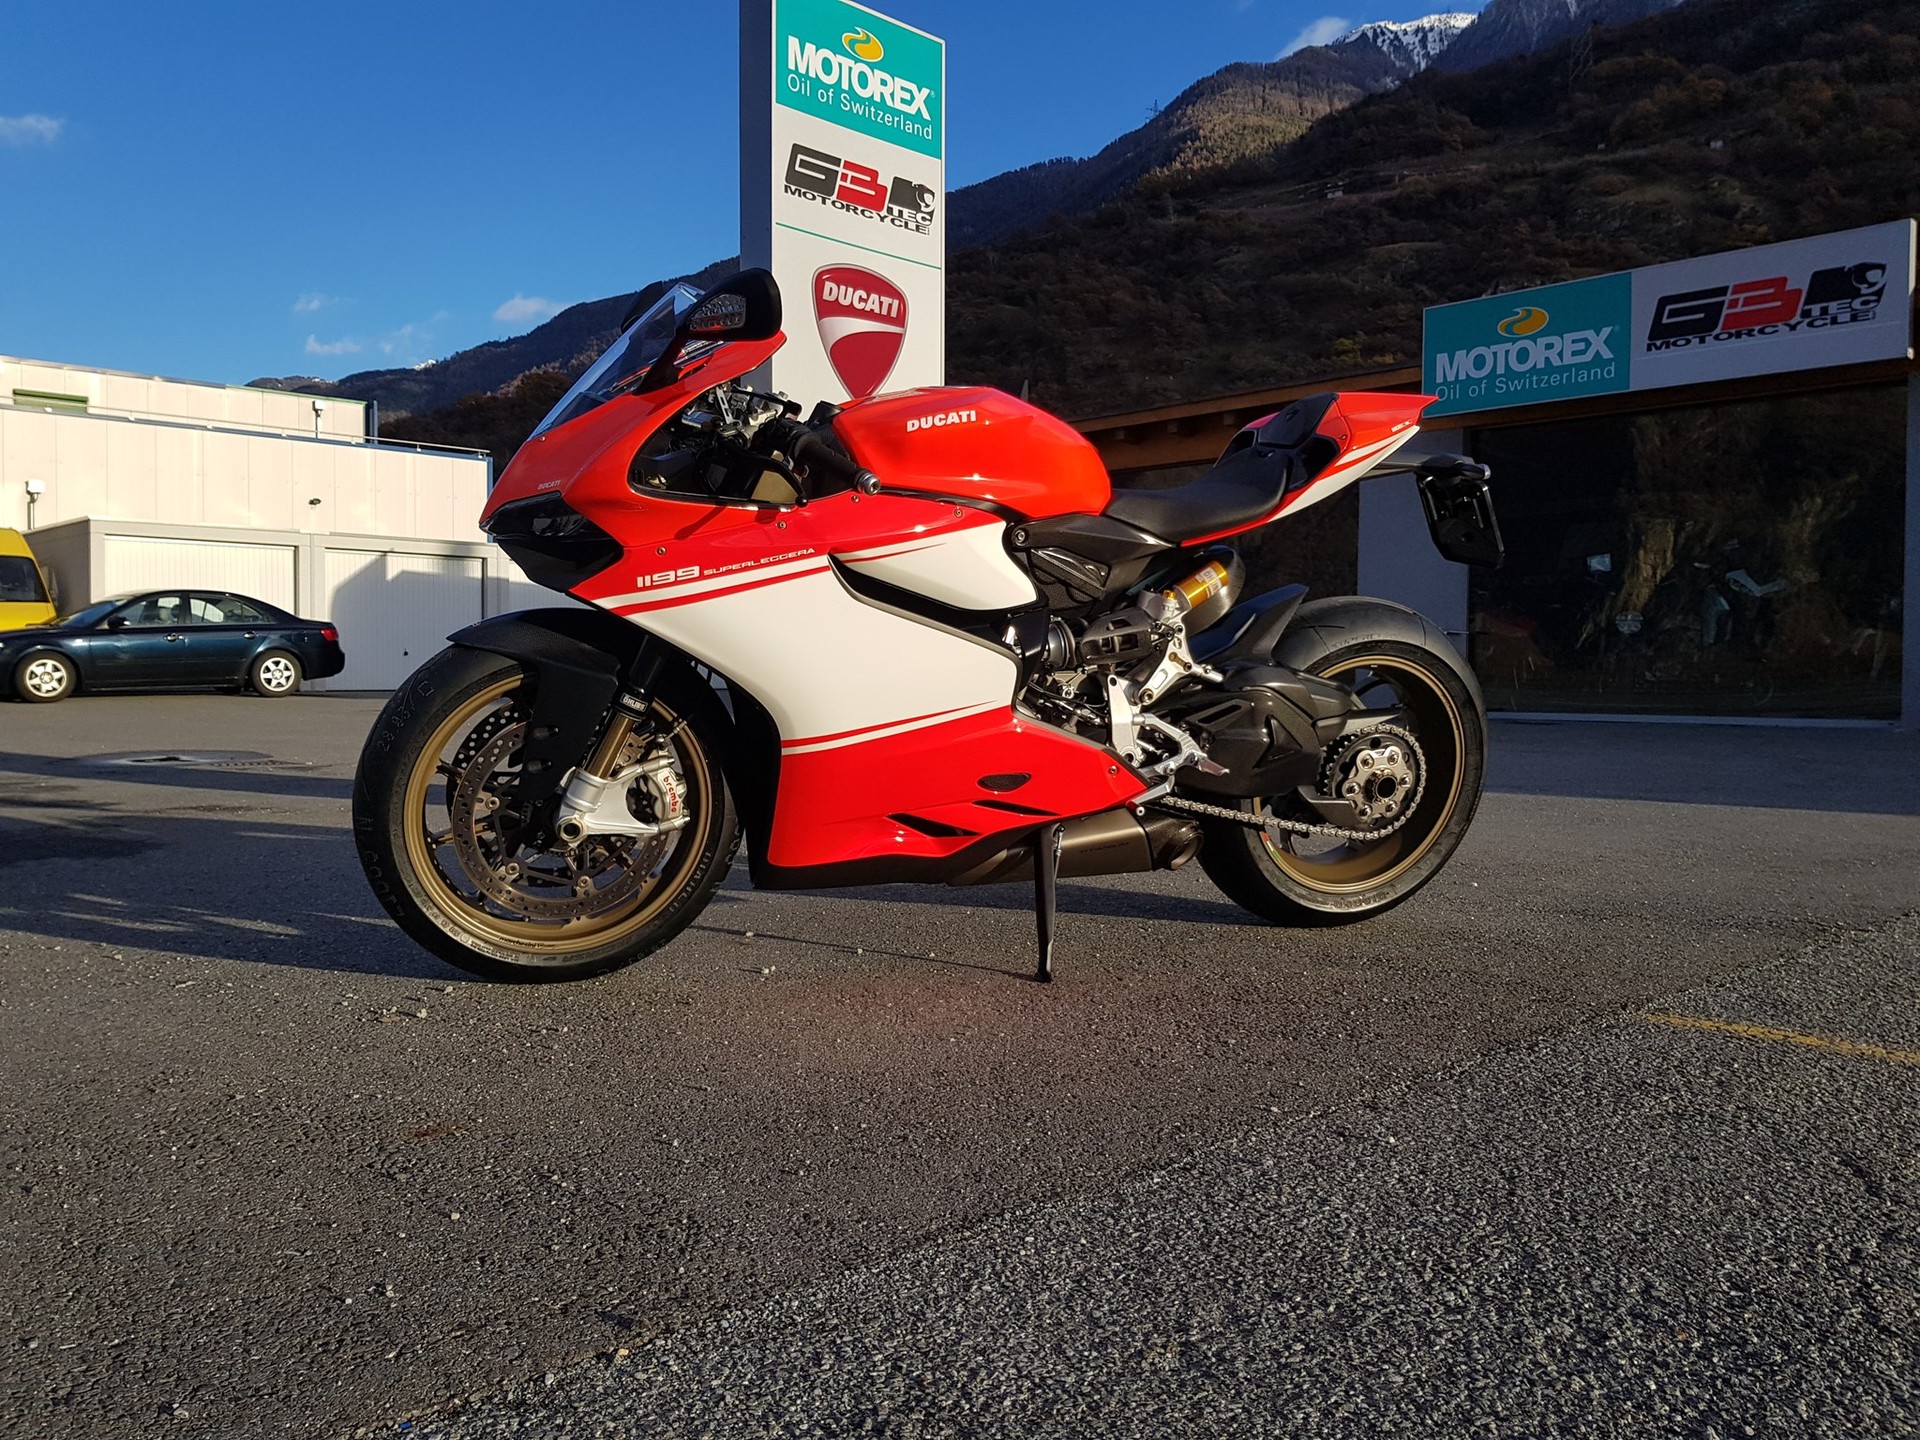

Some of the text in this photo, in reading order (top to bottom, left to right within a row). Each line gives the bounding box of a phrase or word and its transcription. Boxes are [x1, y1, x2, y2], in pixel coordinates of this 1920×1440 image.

[788, 35, 931, 121] MOTOREX
[787, 73, 932, 140] Oil of Switzerland
[784, 184, 928, 235] MOTORCYCLE
[822, 281, 899, 318] DUCATI
[1646, 312, 1874, 352] MOTORCYCLE
[1435, 326, 1614, 383] MOTOREX
[1435, 361, 1615, 401] Oil of Switzerland
[906, 410, 976, 432] DUCATI
[636, 548, 815, 588] 1199 SUPERLEGGERA
[663, 775, 678, 813] brembo
